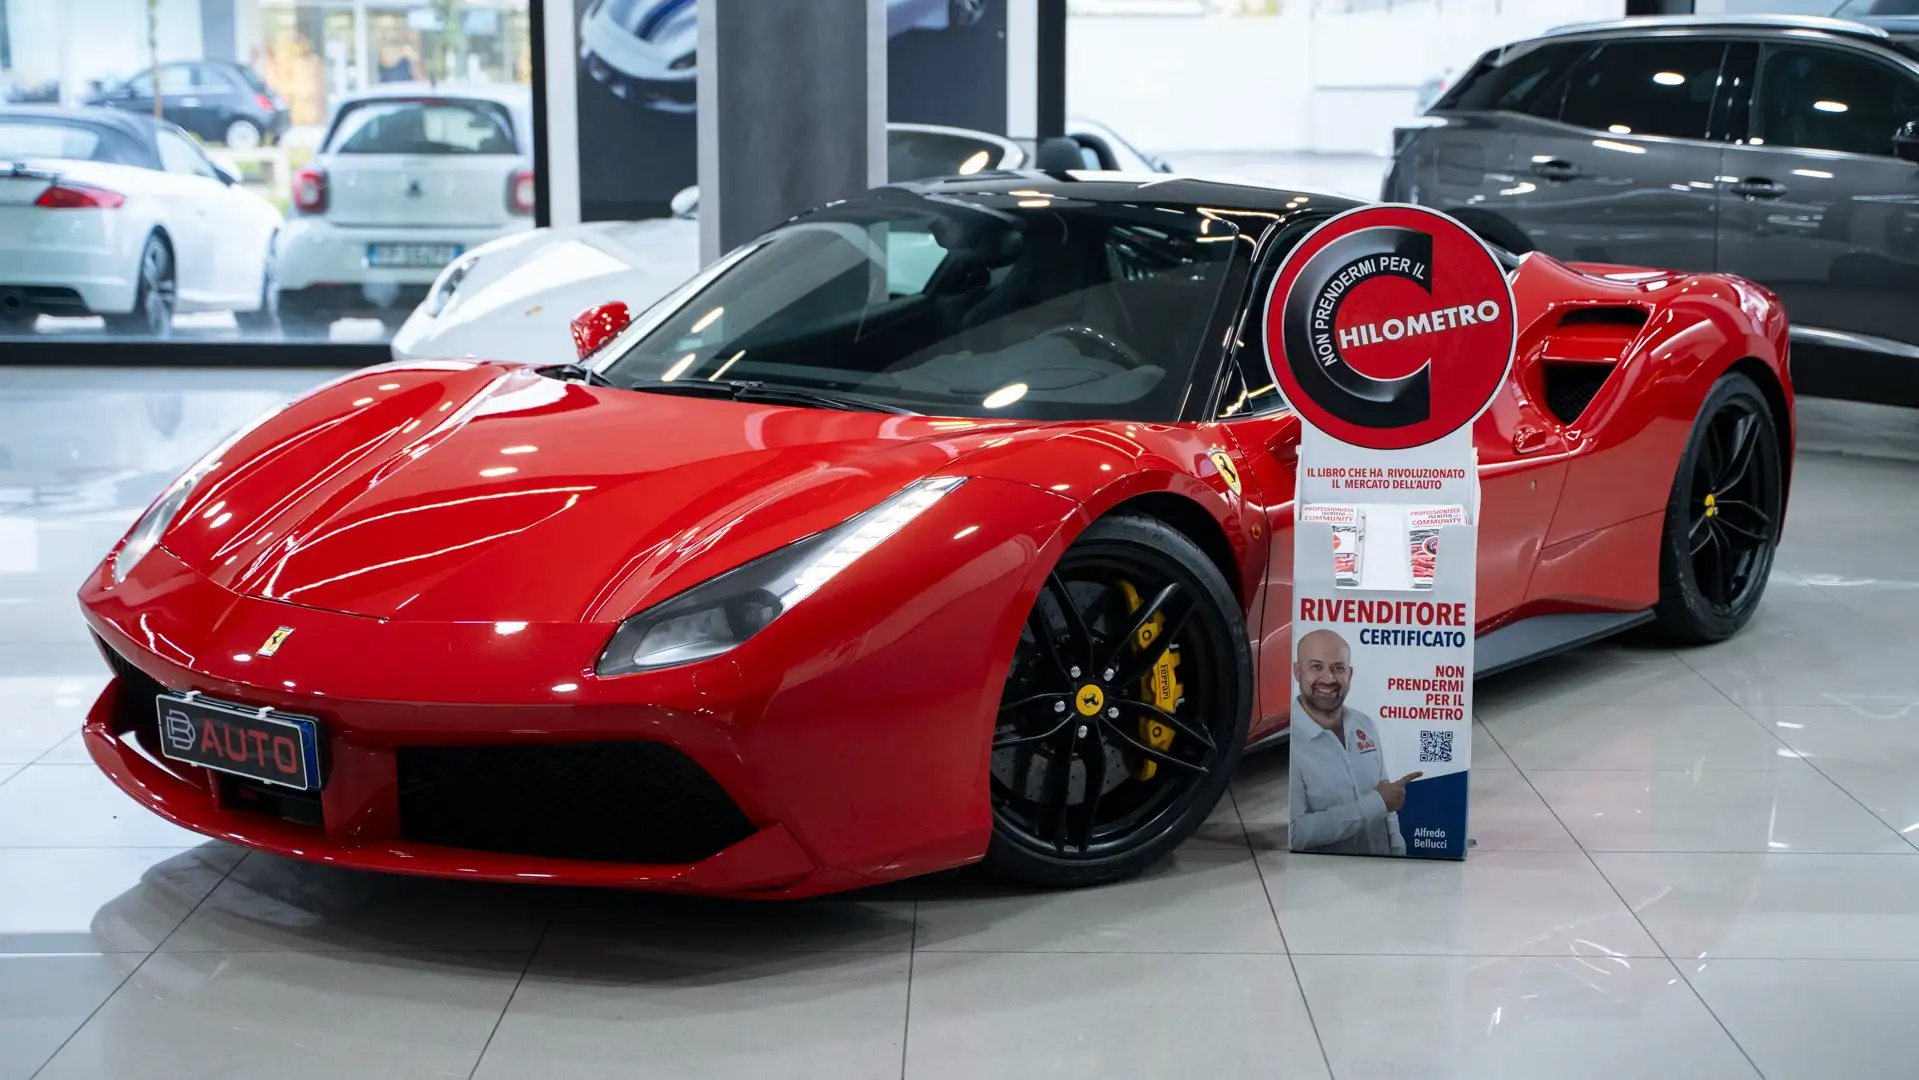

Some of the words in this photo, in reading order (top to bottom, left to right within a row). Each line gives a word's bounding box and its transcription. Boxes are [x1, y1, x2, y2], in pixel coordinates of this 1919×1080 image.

[1380, 256, 1411, 273] PER
[1412, 262, 1426, 280] IL
[1315, 259, 1377, 330] PRENDERMI
[1316, 334, 1338, 367] NON
[1307, 468, 1316, 478] IL
[1317, 468, 1346, 478] LIBRO
[1348, 468, 1368, 478] CHE
[1369, 468, 1383, 478] HA
[1387, 468, 1466, 479] RIVOLUZIONATO
[1332, 479, 1341, 489] IL
[1344, 479, 1390, 489] MERCATO
[1411, 518, 1461, 526] COMMUNITY
[1300, 598, 1466, 627] RIVENDITORE
[1360, 628, 1466, 648] CERTIFICATO
[1435, 665, 1465, 678] NON
[1160, 664, 1170, 700] Ferrari
[1387, 678, 1464, 692] PRENDERMI
[1425, 693, 1450, 706] PER
[1453, 694, 1465, 707] IL
[1379, 706, 1464, 721] CHILOMETRO
[201, 718, 298, 774] AUTO
[1414, 828, 1446, 838] Alfredo
[1414, 838, 1447, 849] Bellucci
